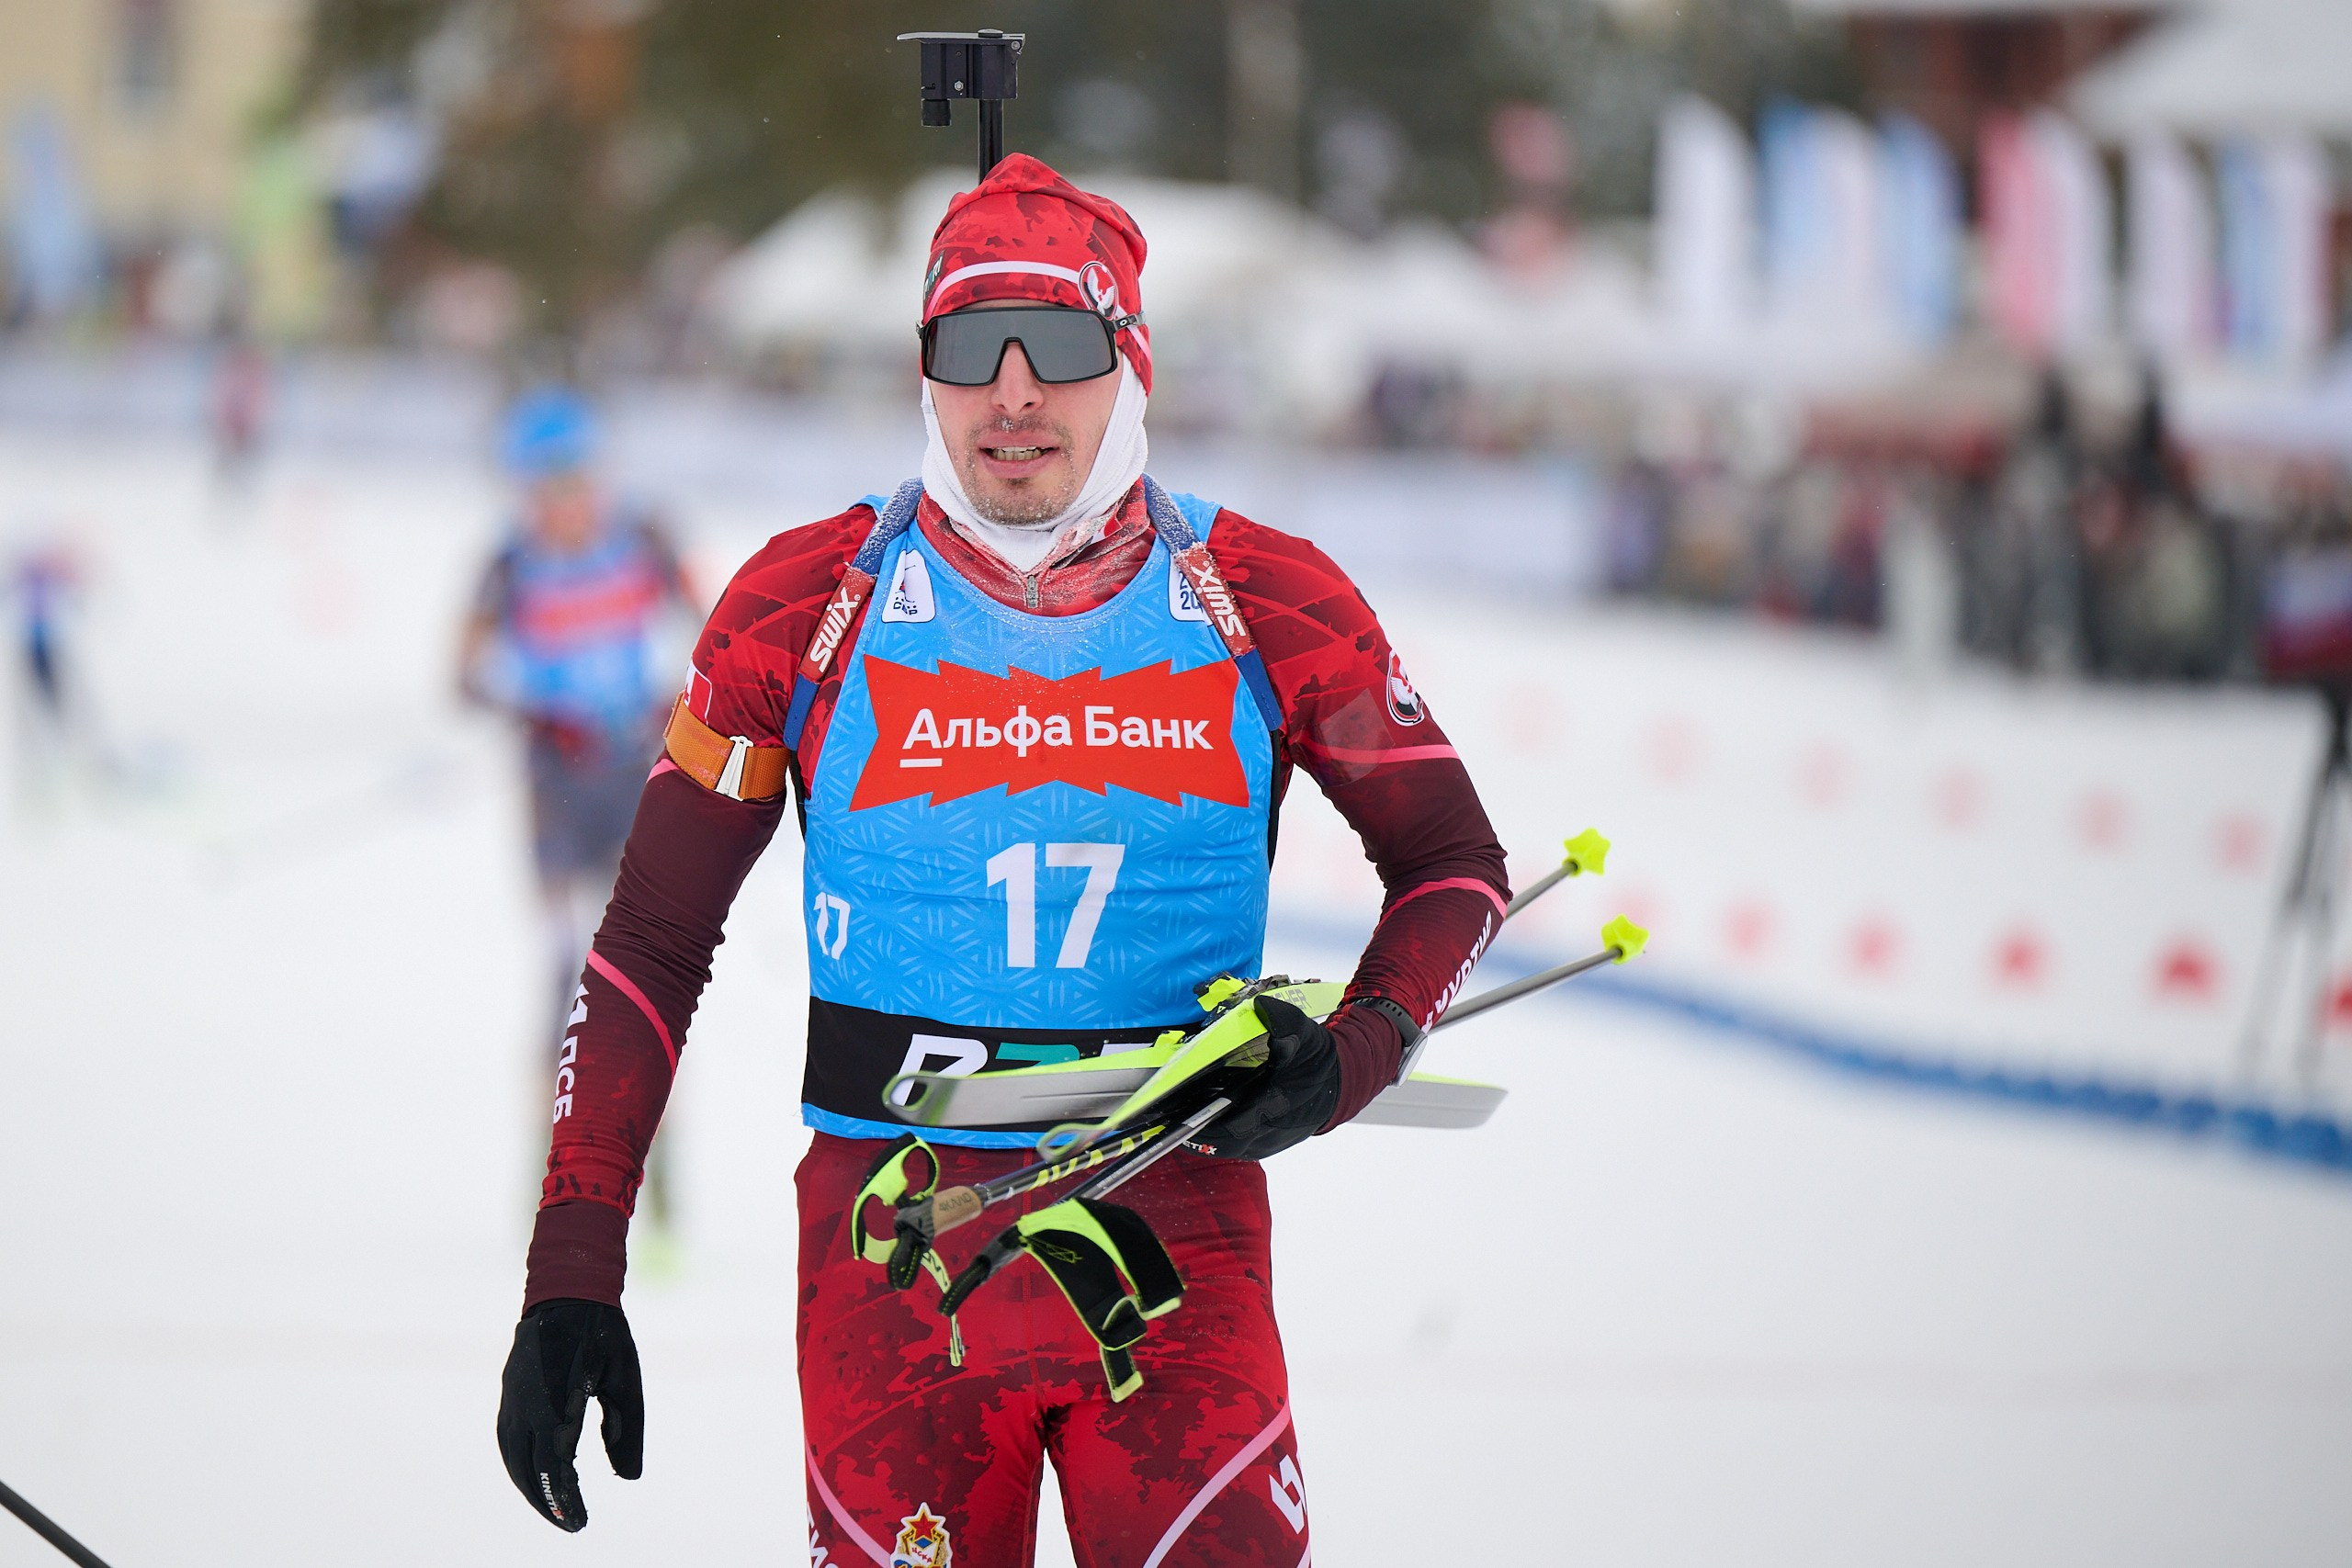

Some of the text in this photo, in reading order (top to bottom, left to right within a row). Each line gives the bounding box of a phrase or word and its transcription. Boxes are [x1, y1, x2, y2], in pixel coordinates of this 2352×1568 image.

[899, 705, 1214, 768] Альфа Банк
[812, 891, 852, 961] 17
[986, 842, 1126, 969] 17
